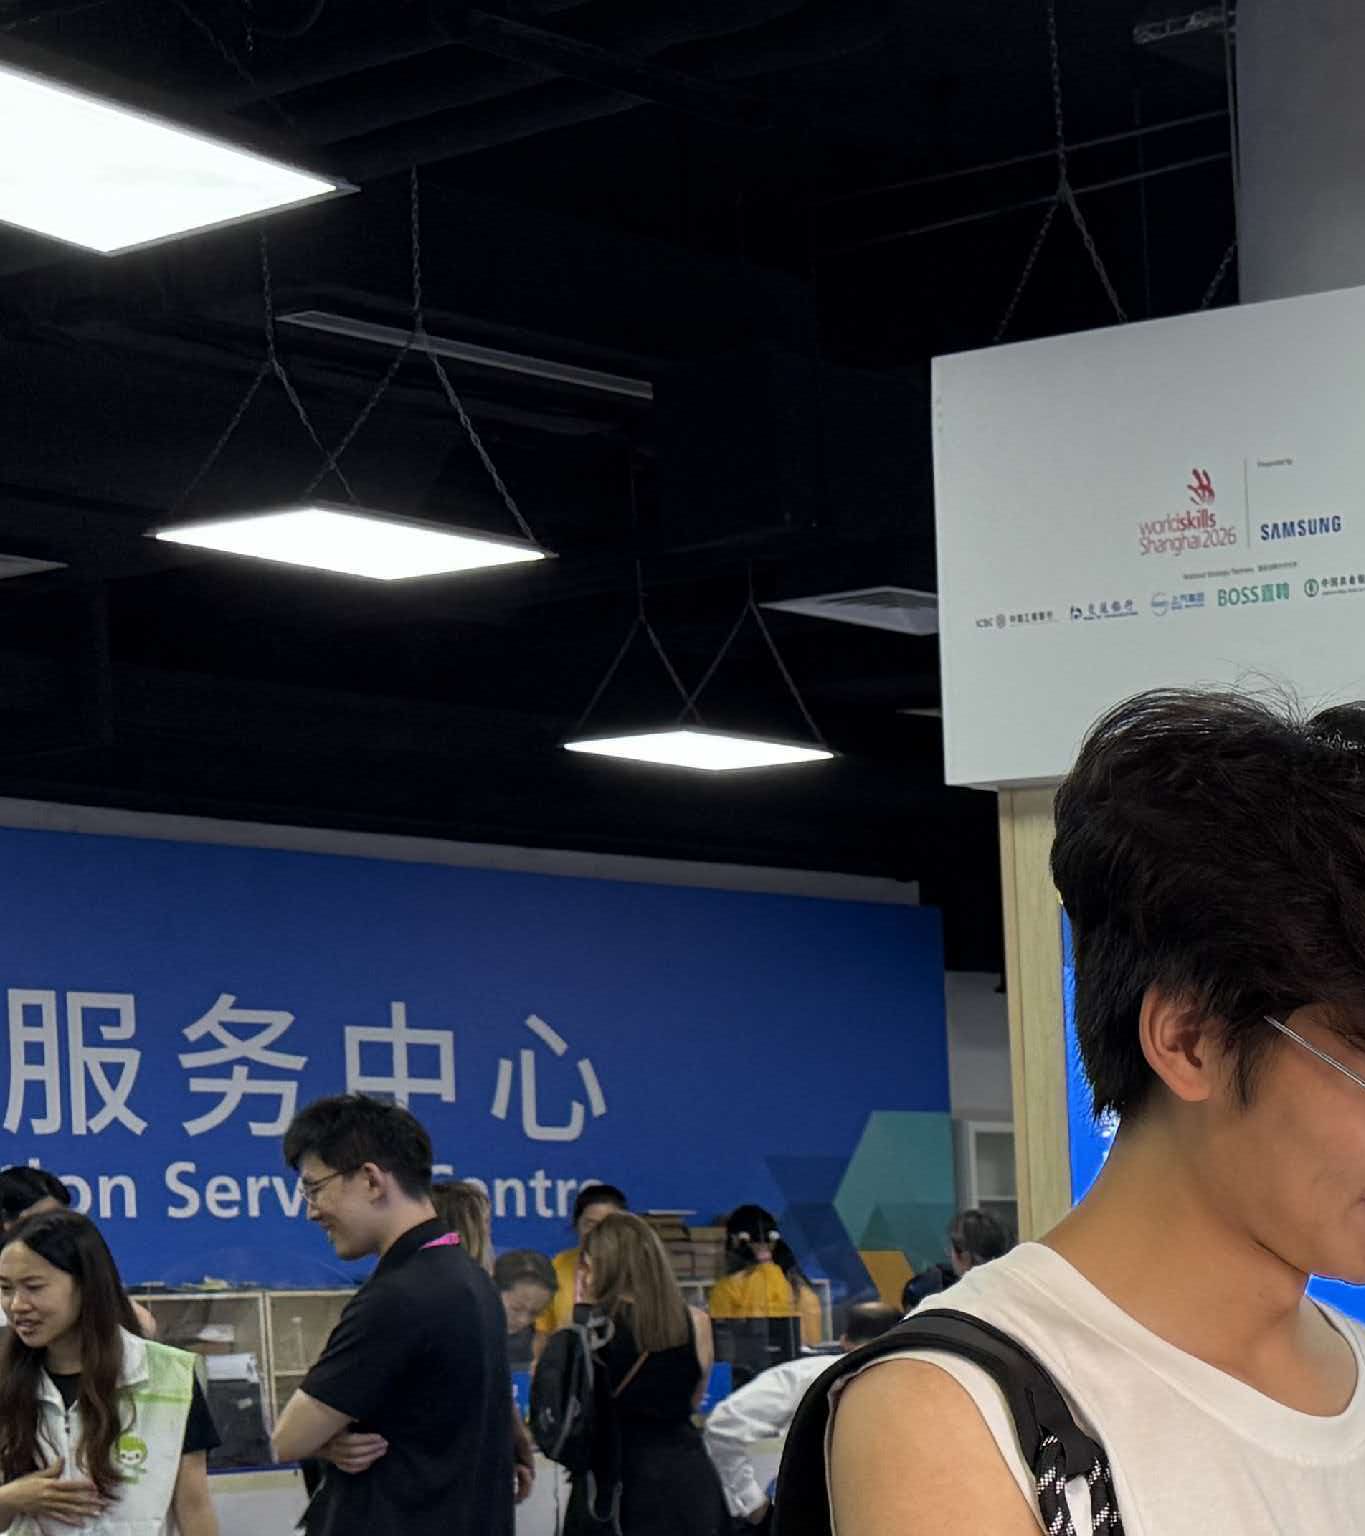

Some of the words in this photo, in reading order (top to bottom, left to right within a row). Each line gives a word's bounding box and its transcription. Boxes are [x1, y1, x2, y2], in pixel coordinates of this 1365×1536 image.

[1139, 509, 1216, 535] worldskills
[1261, 515, 1341, 541] SAMSUNG
[1202, 527, 1237, 549] 2026
[1217, 582, 1290, 607] BOSS直聘
[3, 987, 607, 1142] 服务中心
